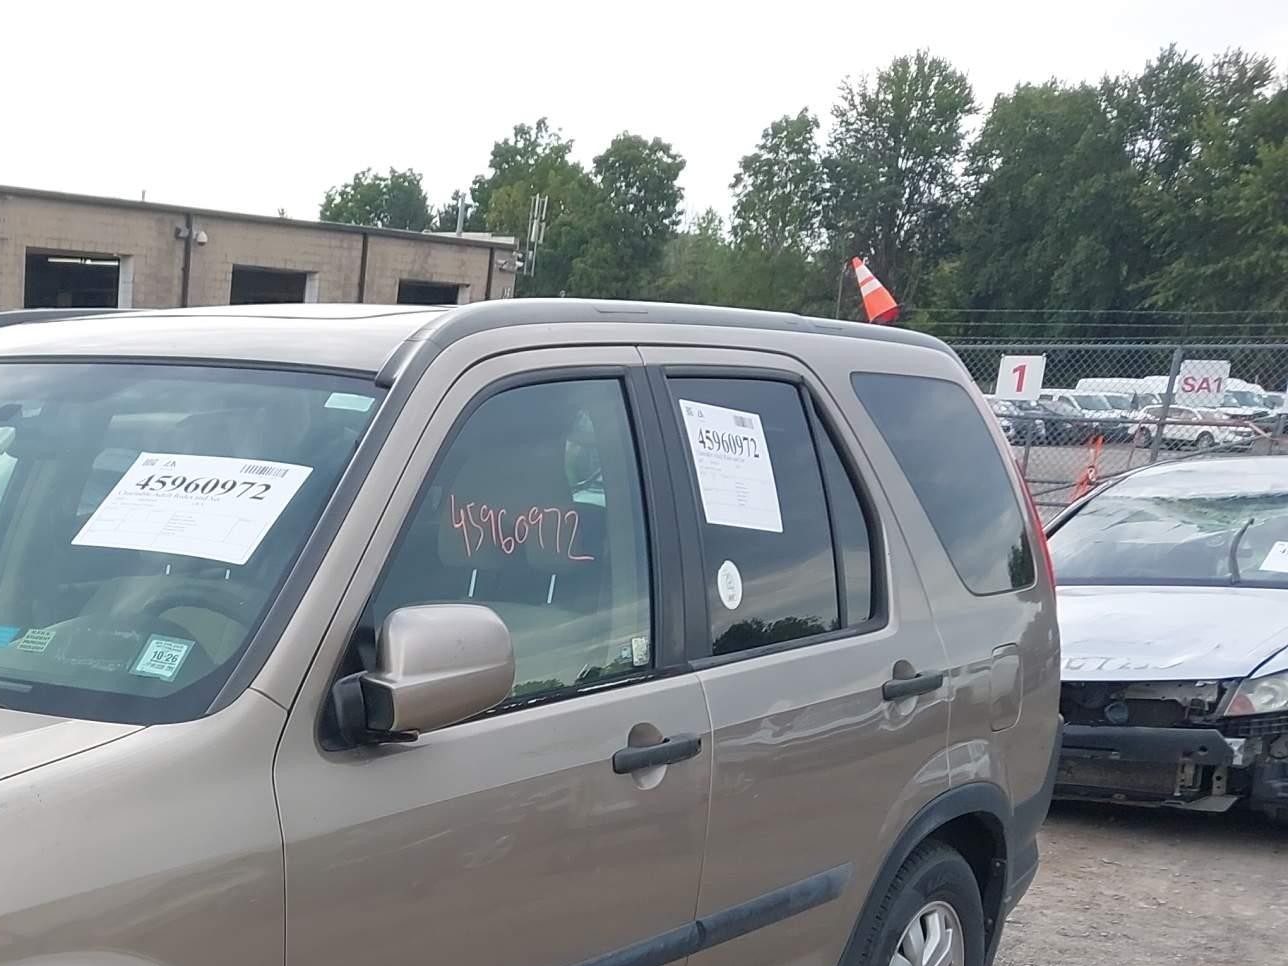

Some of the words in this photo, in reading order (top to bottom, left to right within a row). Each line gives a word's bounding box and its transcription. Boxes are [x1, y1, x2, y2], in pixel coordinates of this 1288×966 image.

[1012, 364, 1027, 393] 1
[1180, 376, 1223, 393] SA1
[699, 428, 760, 458] 45960972
[135, 474, 272, 500] 45960972
[450, 494, 595, 561] 45960972
